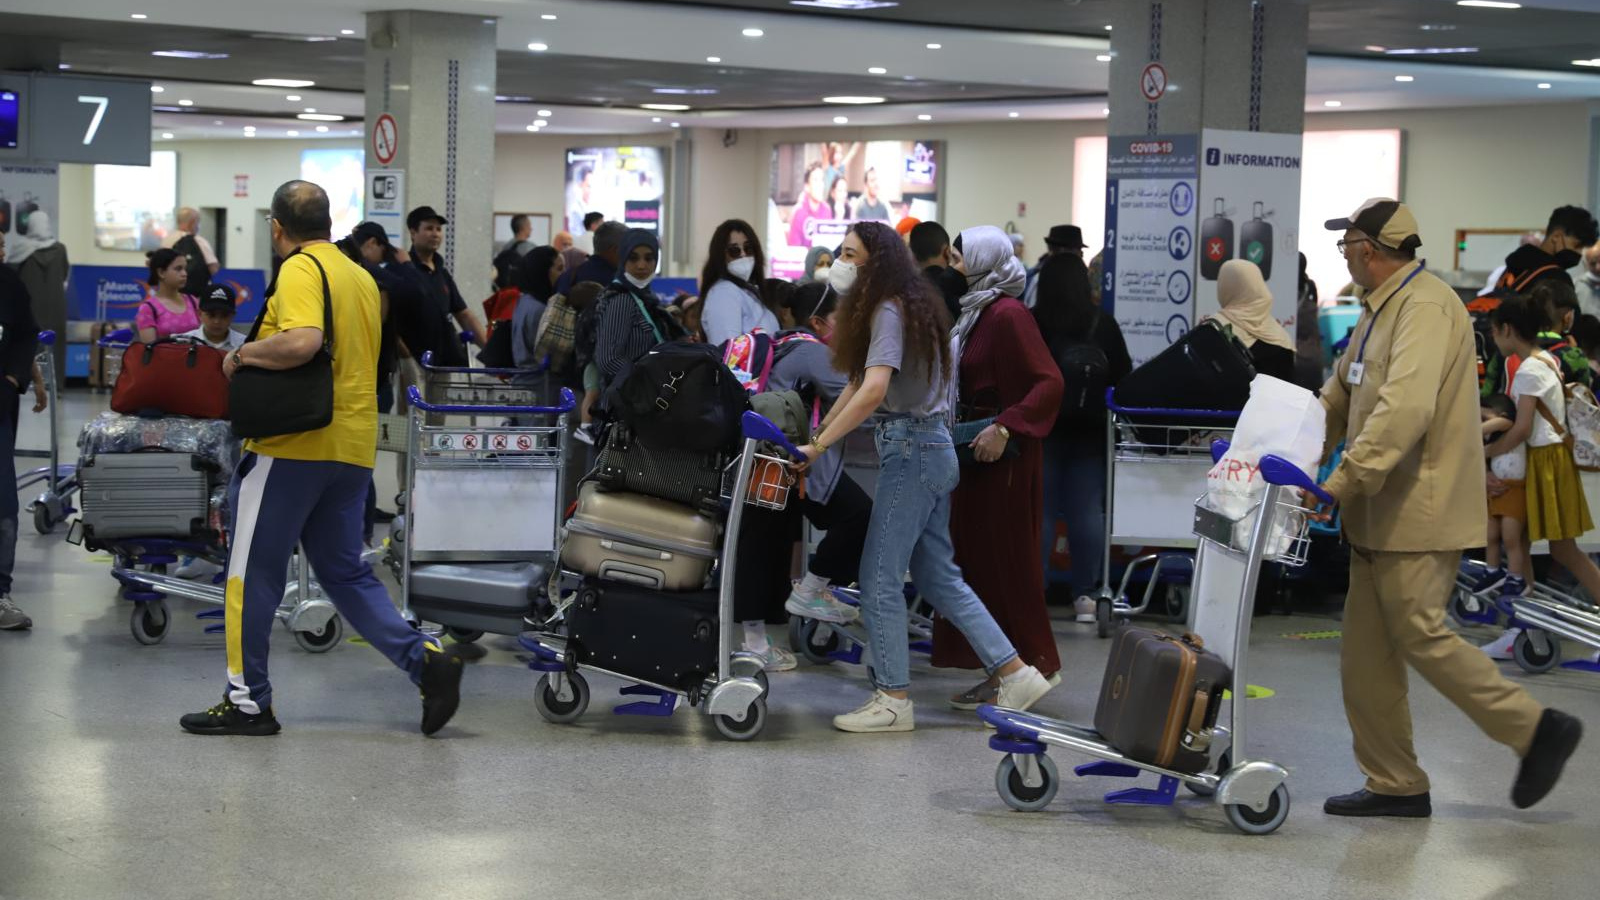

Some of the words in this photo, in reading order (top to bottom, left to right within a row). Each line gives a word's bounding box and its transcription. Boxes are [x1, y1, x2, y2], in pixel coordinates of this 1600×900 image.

[78, 96, 108, 145] 7
[1130, 142, 1173, 154] COVID-19
[1223, 153, 1300, 169] INFORMATION
[1, 165, 57, 175] INFORMATION
[1109, 186, 1115, 205] 1
[1107, 229, 1115, 248] 2
[105, 281, 140, 291] Maroc
[1105, 271, 1113, 291] 3
